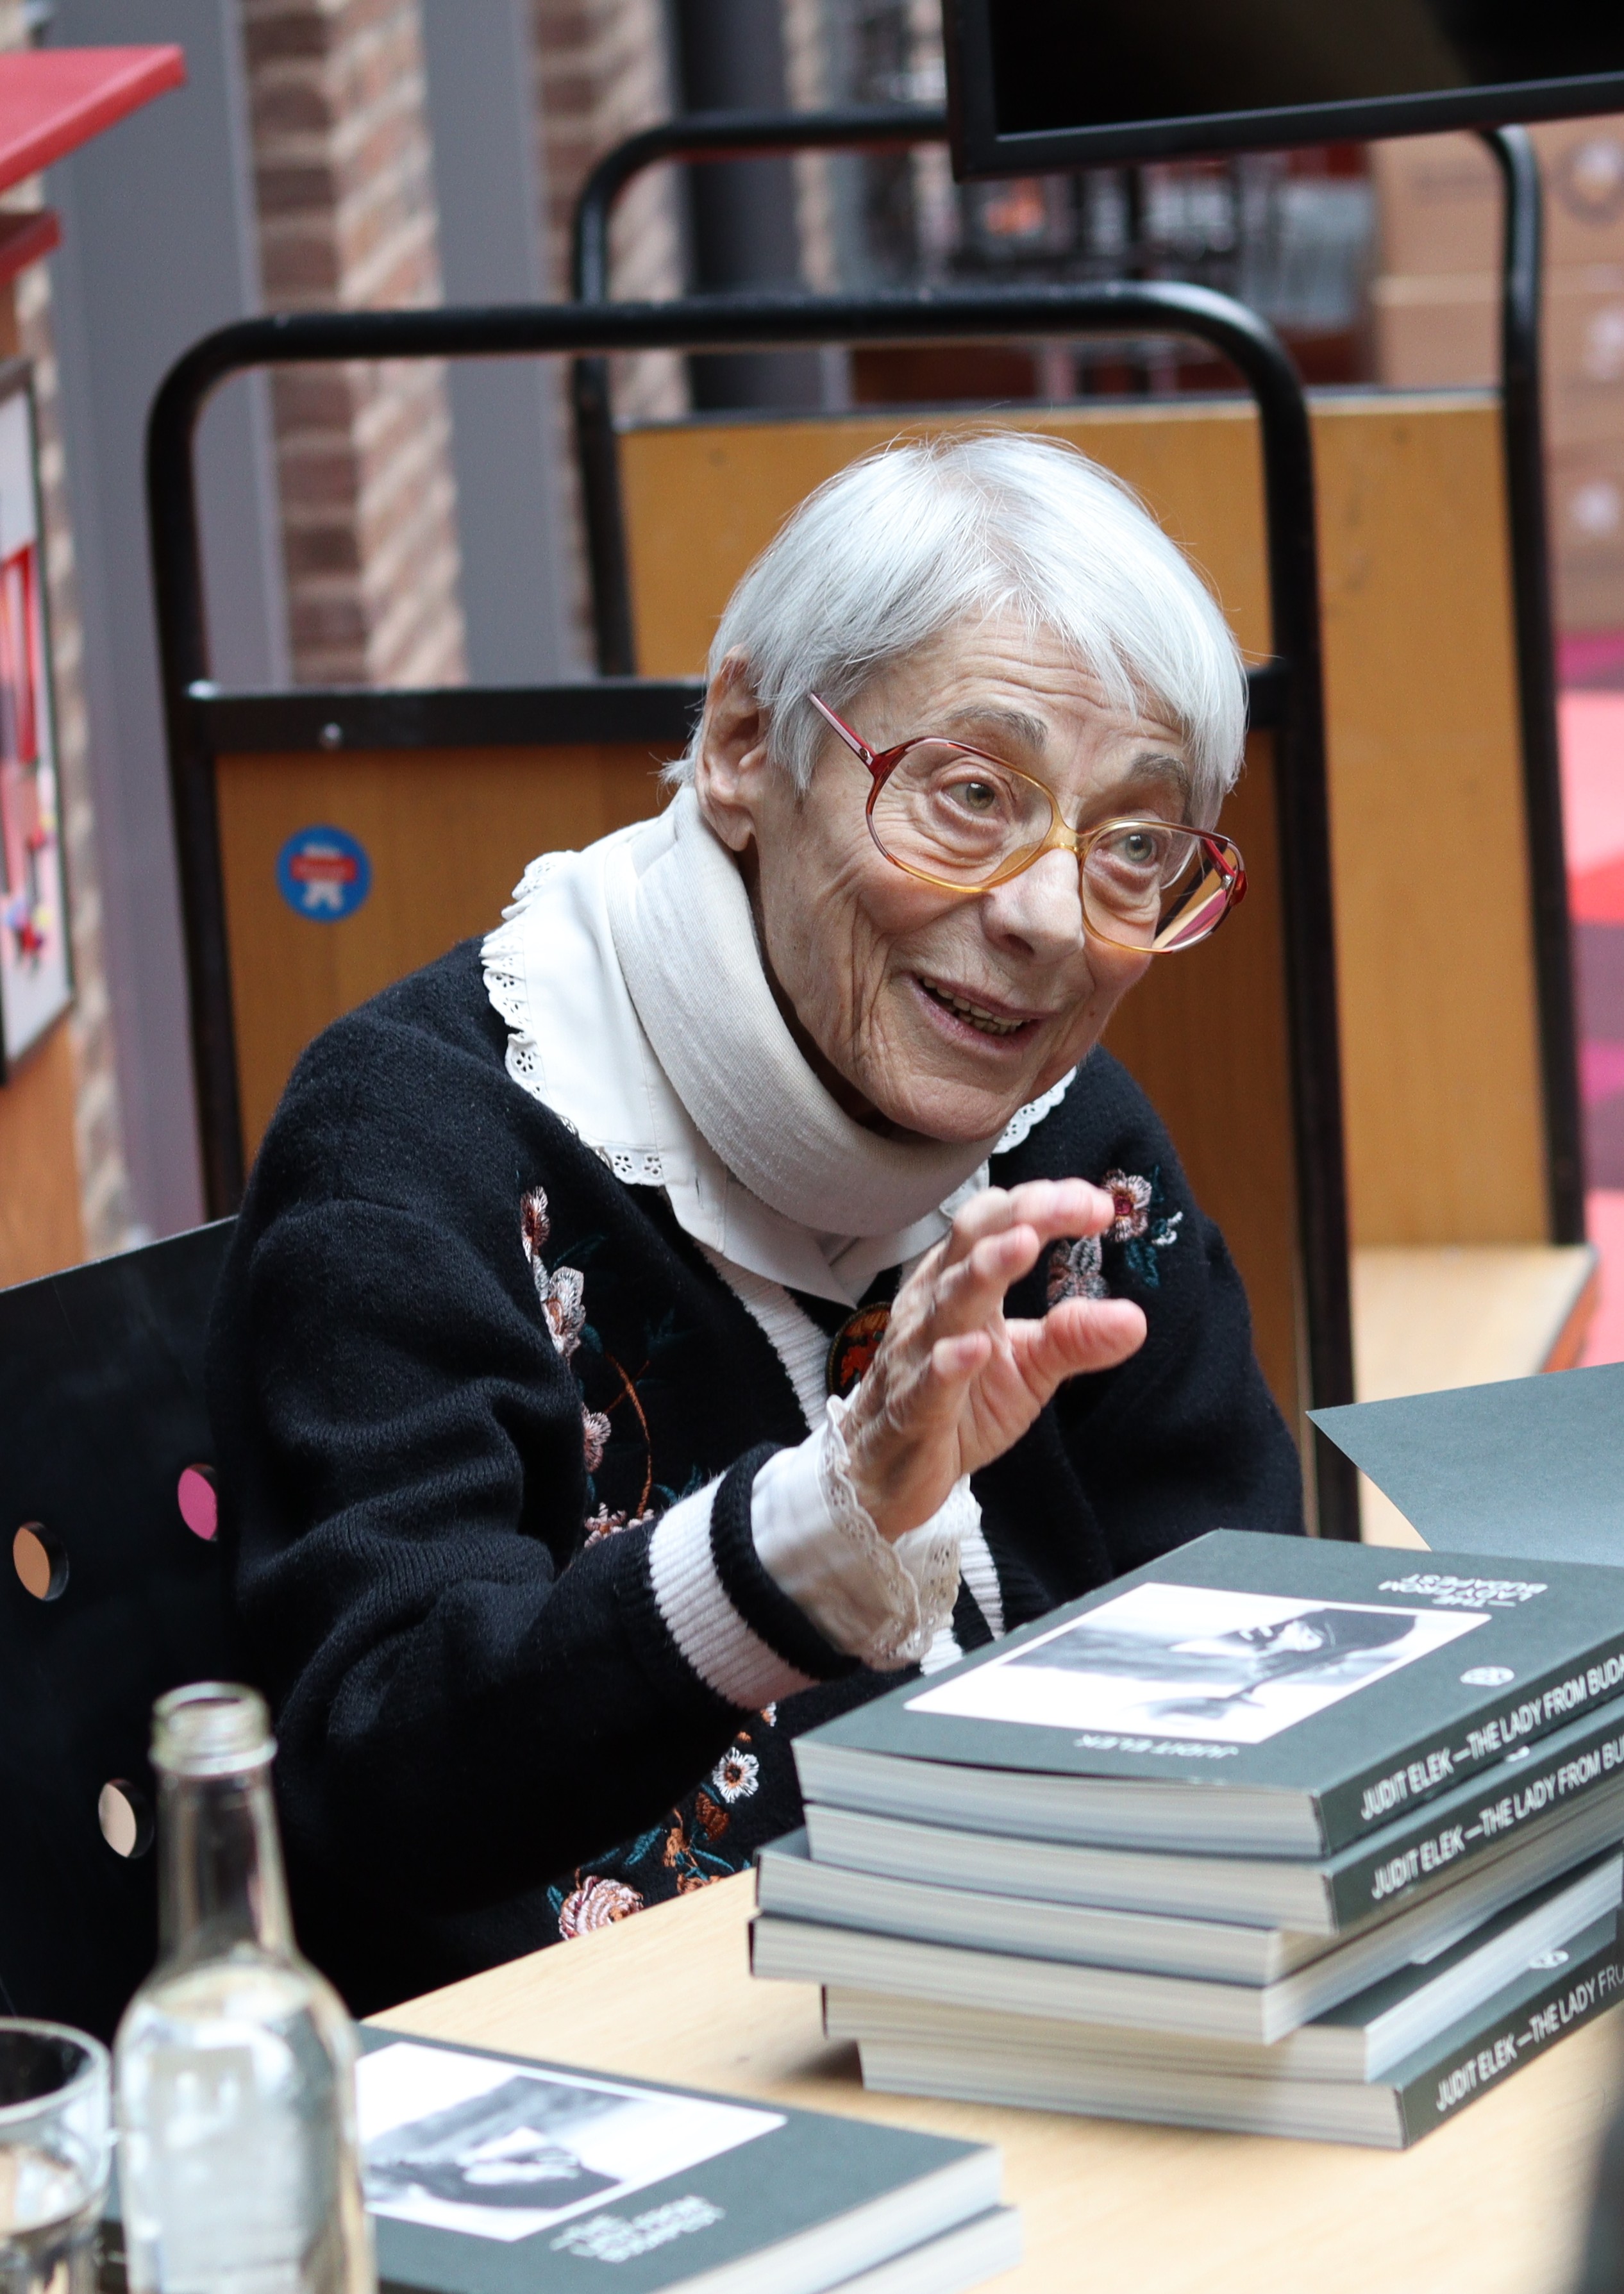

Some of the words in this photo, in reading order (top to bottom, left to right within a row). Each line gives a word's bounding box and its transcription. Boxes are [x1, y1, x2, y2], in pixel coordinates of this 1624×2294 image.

[1360, 1770, 1408, 1820] JUDIT
[1406, 1746, 1455, 1793] ELEK
[1499, 1697, 1542, 1744] LADY
[1543, 1674, 1587, 1720] FROM
[1371, 1848, 1419, 1900] JUDIT
[1419, 1824, 1466, 1872] ELEK
[1512, 1772, 1556, 1820] LADY
[1557, 1748, 1602, 1795] FROM
[1436, 2058, 1477, 2112] JUDIT
[1476, 2032, 1518, 2082] ELEK
[1558, 1975, 1595, 2024] LADY
